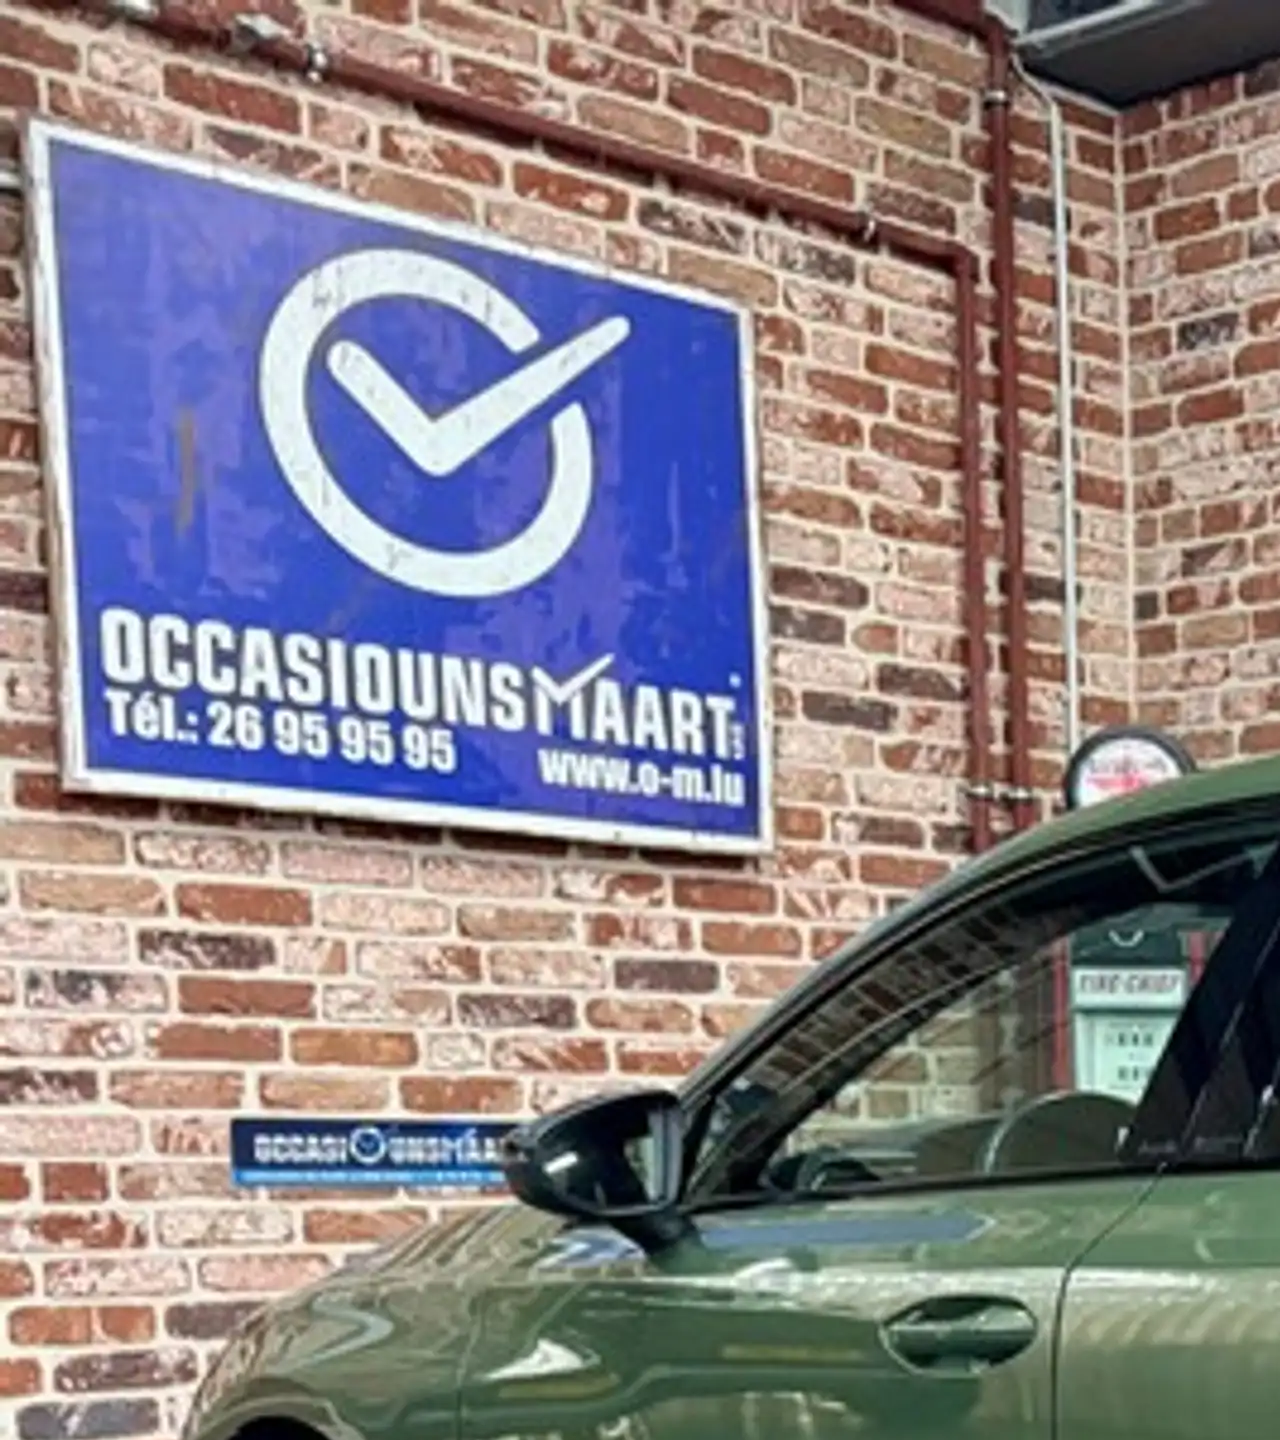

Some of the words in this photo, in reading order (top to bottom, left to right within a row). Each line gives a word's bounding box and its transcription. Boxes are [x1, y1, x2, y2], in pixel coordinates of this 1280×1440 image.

[100, 607, 735, 759] OCCASIOUNSMAART
[105, 690, 199, 746] Tél.:
[207, 707, 263, 752] 26
[275, 712, 328, 758] 95
[340, 718, 394, 765] 95
[404, 724, 456, 772] 95
[537, 749, 745, 807] www.o-m.lu
